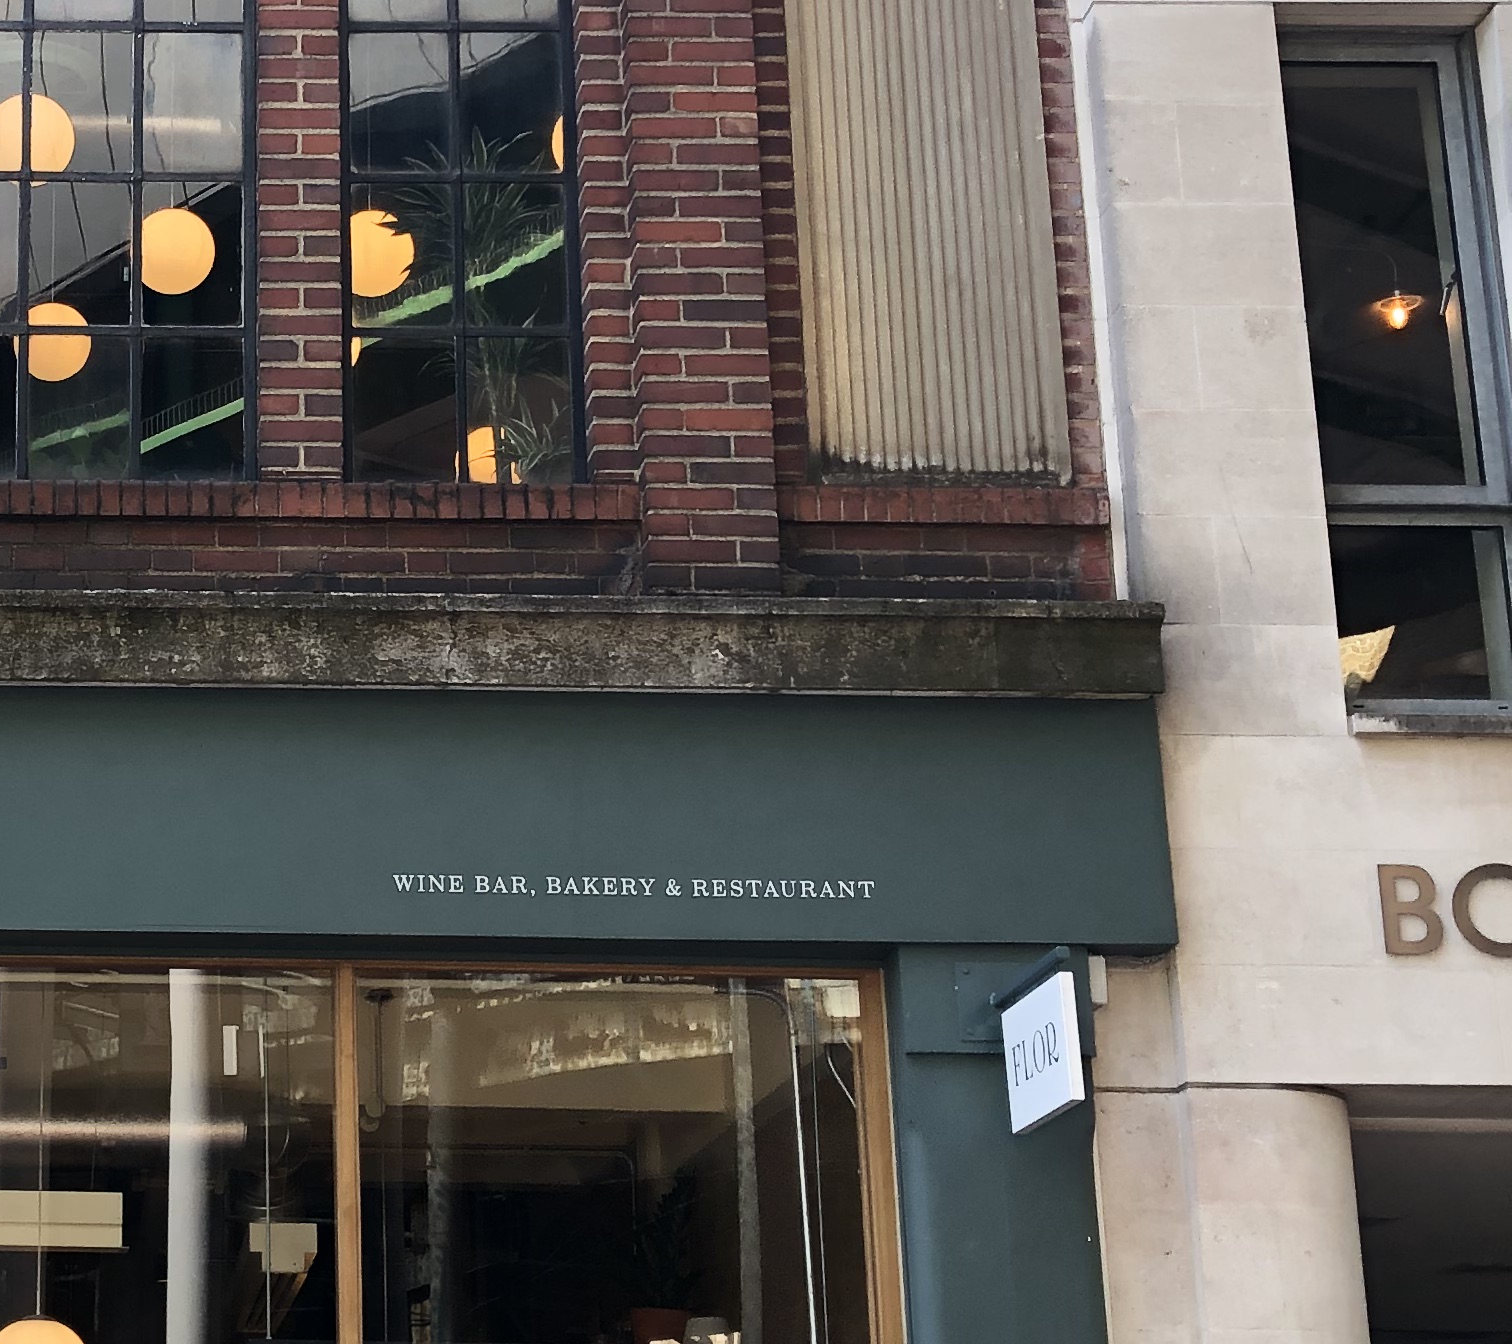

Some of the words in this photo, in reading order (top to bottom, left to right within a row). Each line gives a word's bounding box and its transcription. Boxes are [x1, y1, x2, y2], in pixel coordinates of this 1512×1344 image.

[392, 874, 464, 893] WINE
[474, 875, 536, 897] BAR,
[545, 876, 656, 897] BAKERY
[665, 878, 682, 897] &
[691, 879, 876, 899] RESTAURANT
[1012, 1021, 1060, 1087] FLOR
